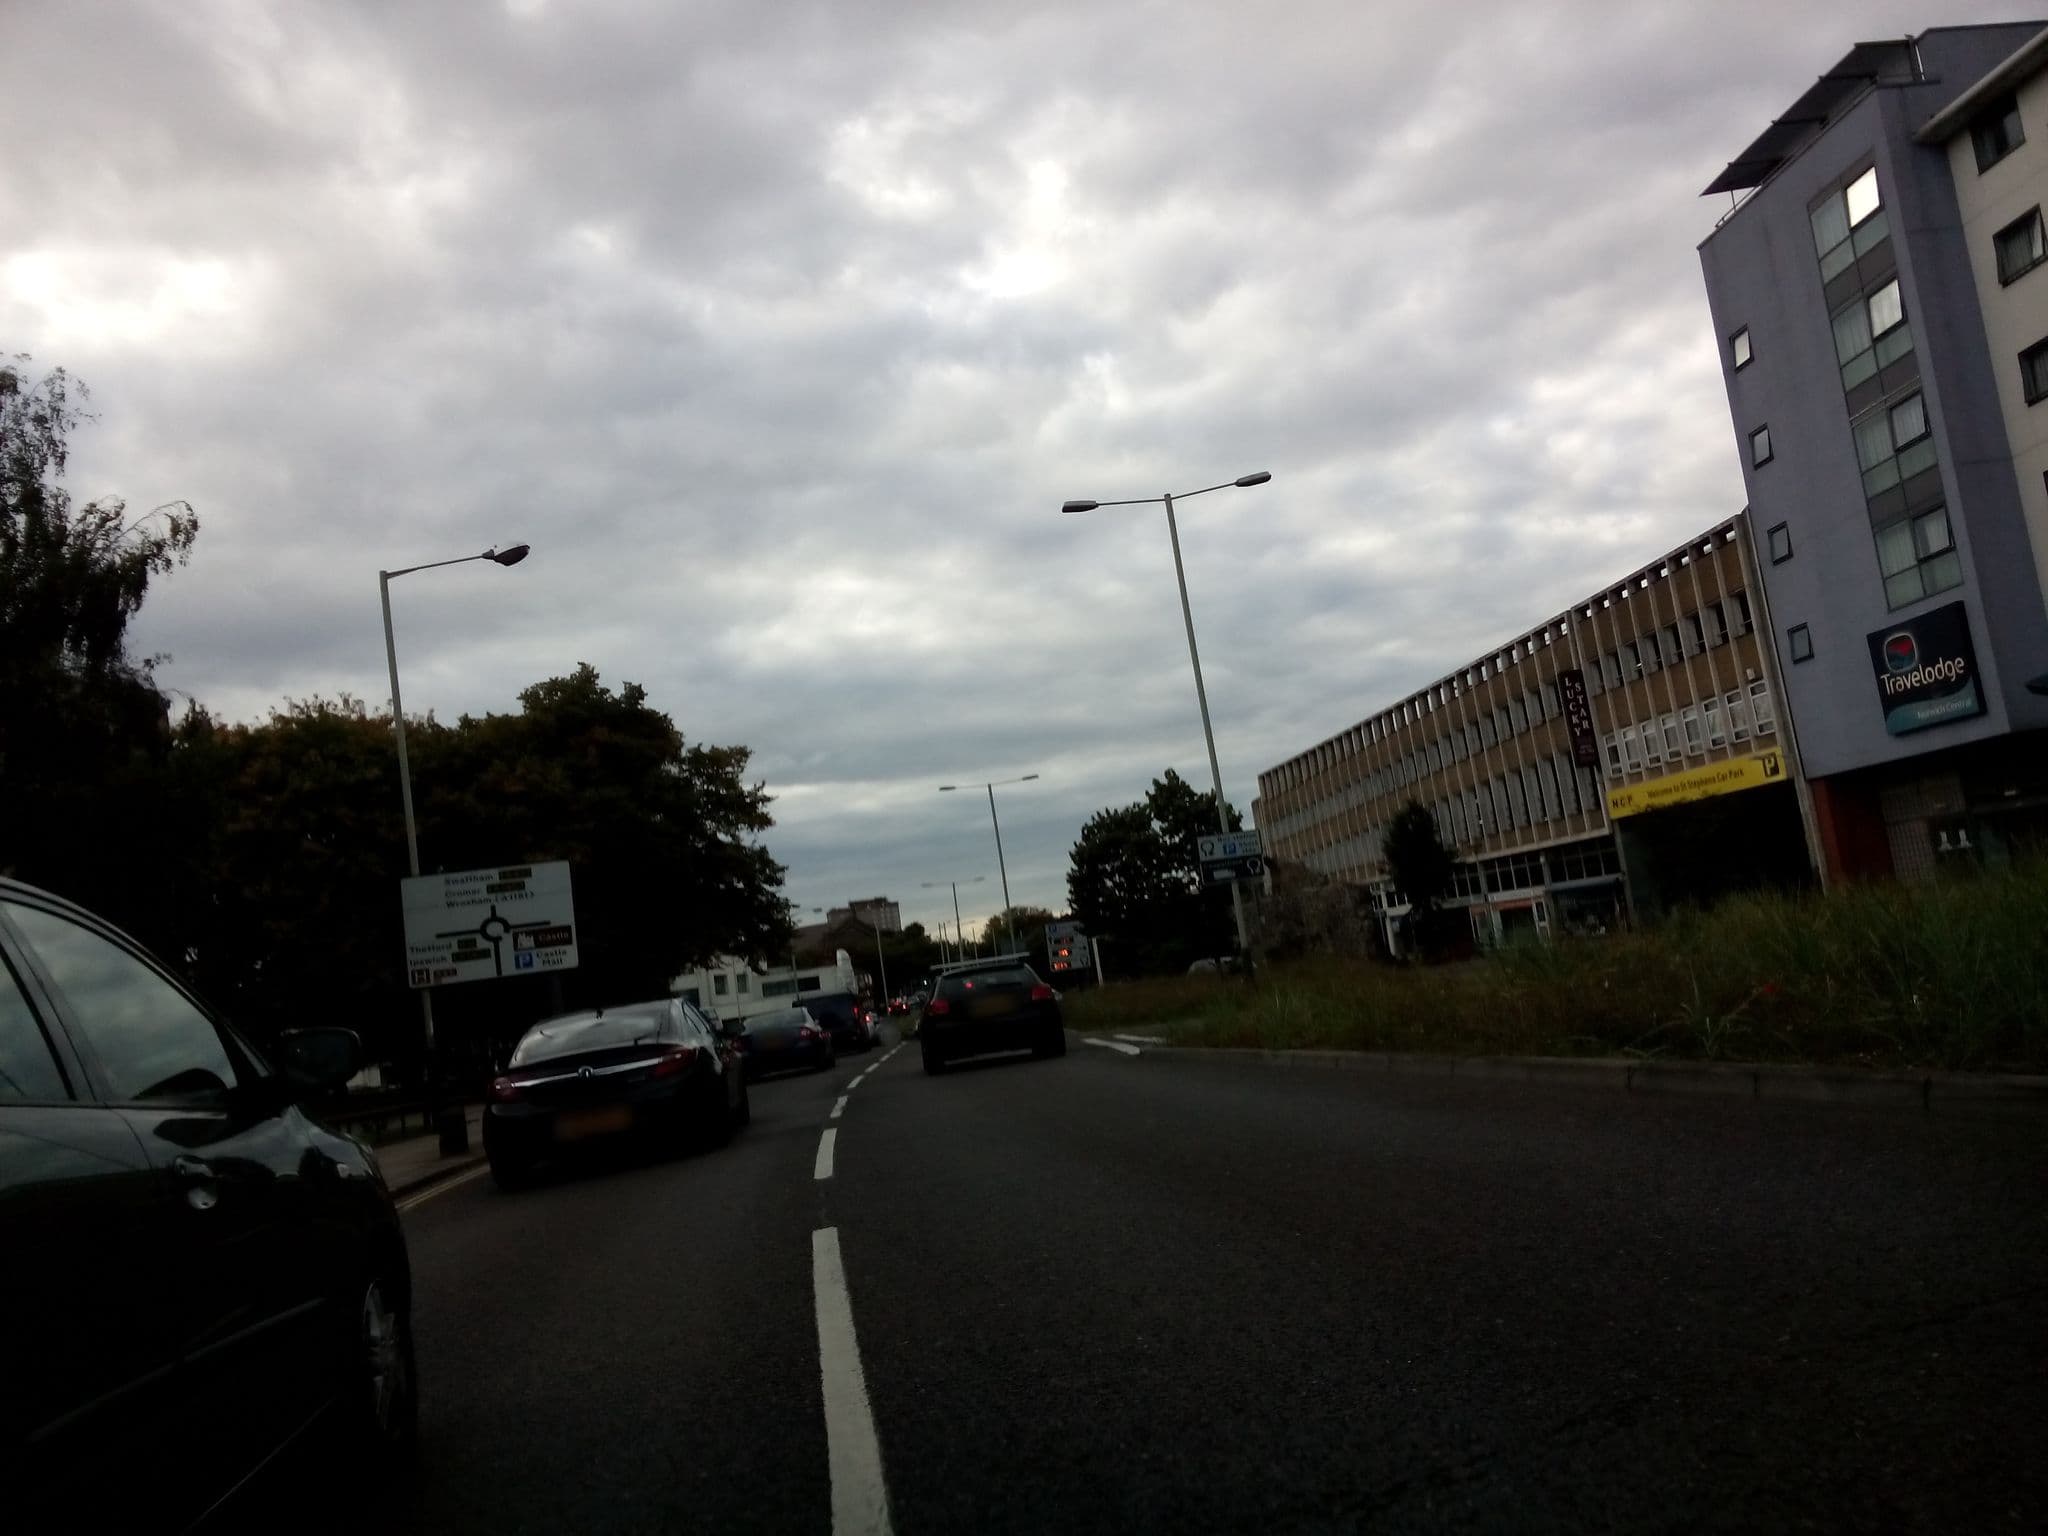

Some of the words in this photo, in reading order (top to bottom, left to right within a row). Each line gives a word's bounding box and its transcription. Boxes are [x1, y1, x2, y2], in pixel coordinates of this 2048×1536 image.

[1880, 656, 1965, 696] Travelodge
[1565, 676, 1582, 737] LUCKY
[1728, 767, 1746, 781] Park
